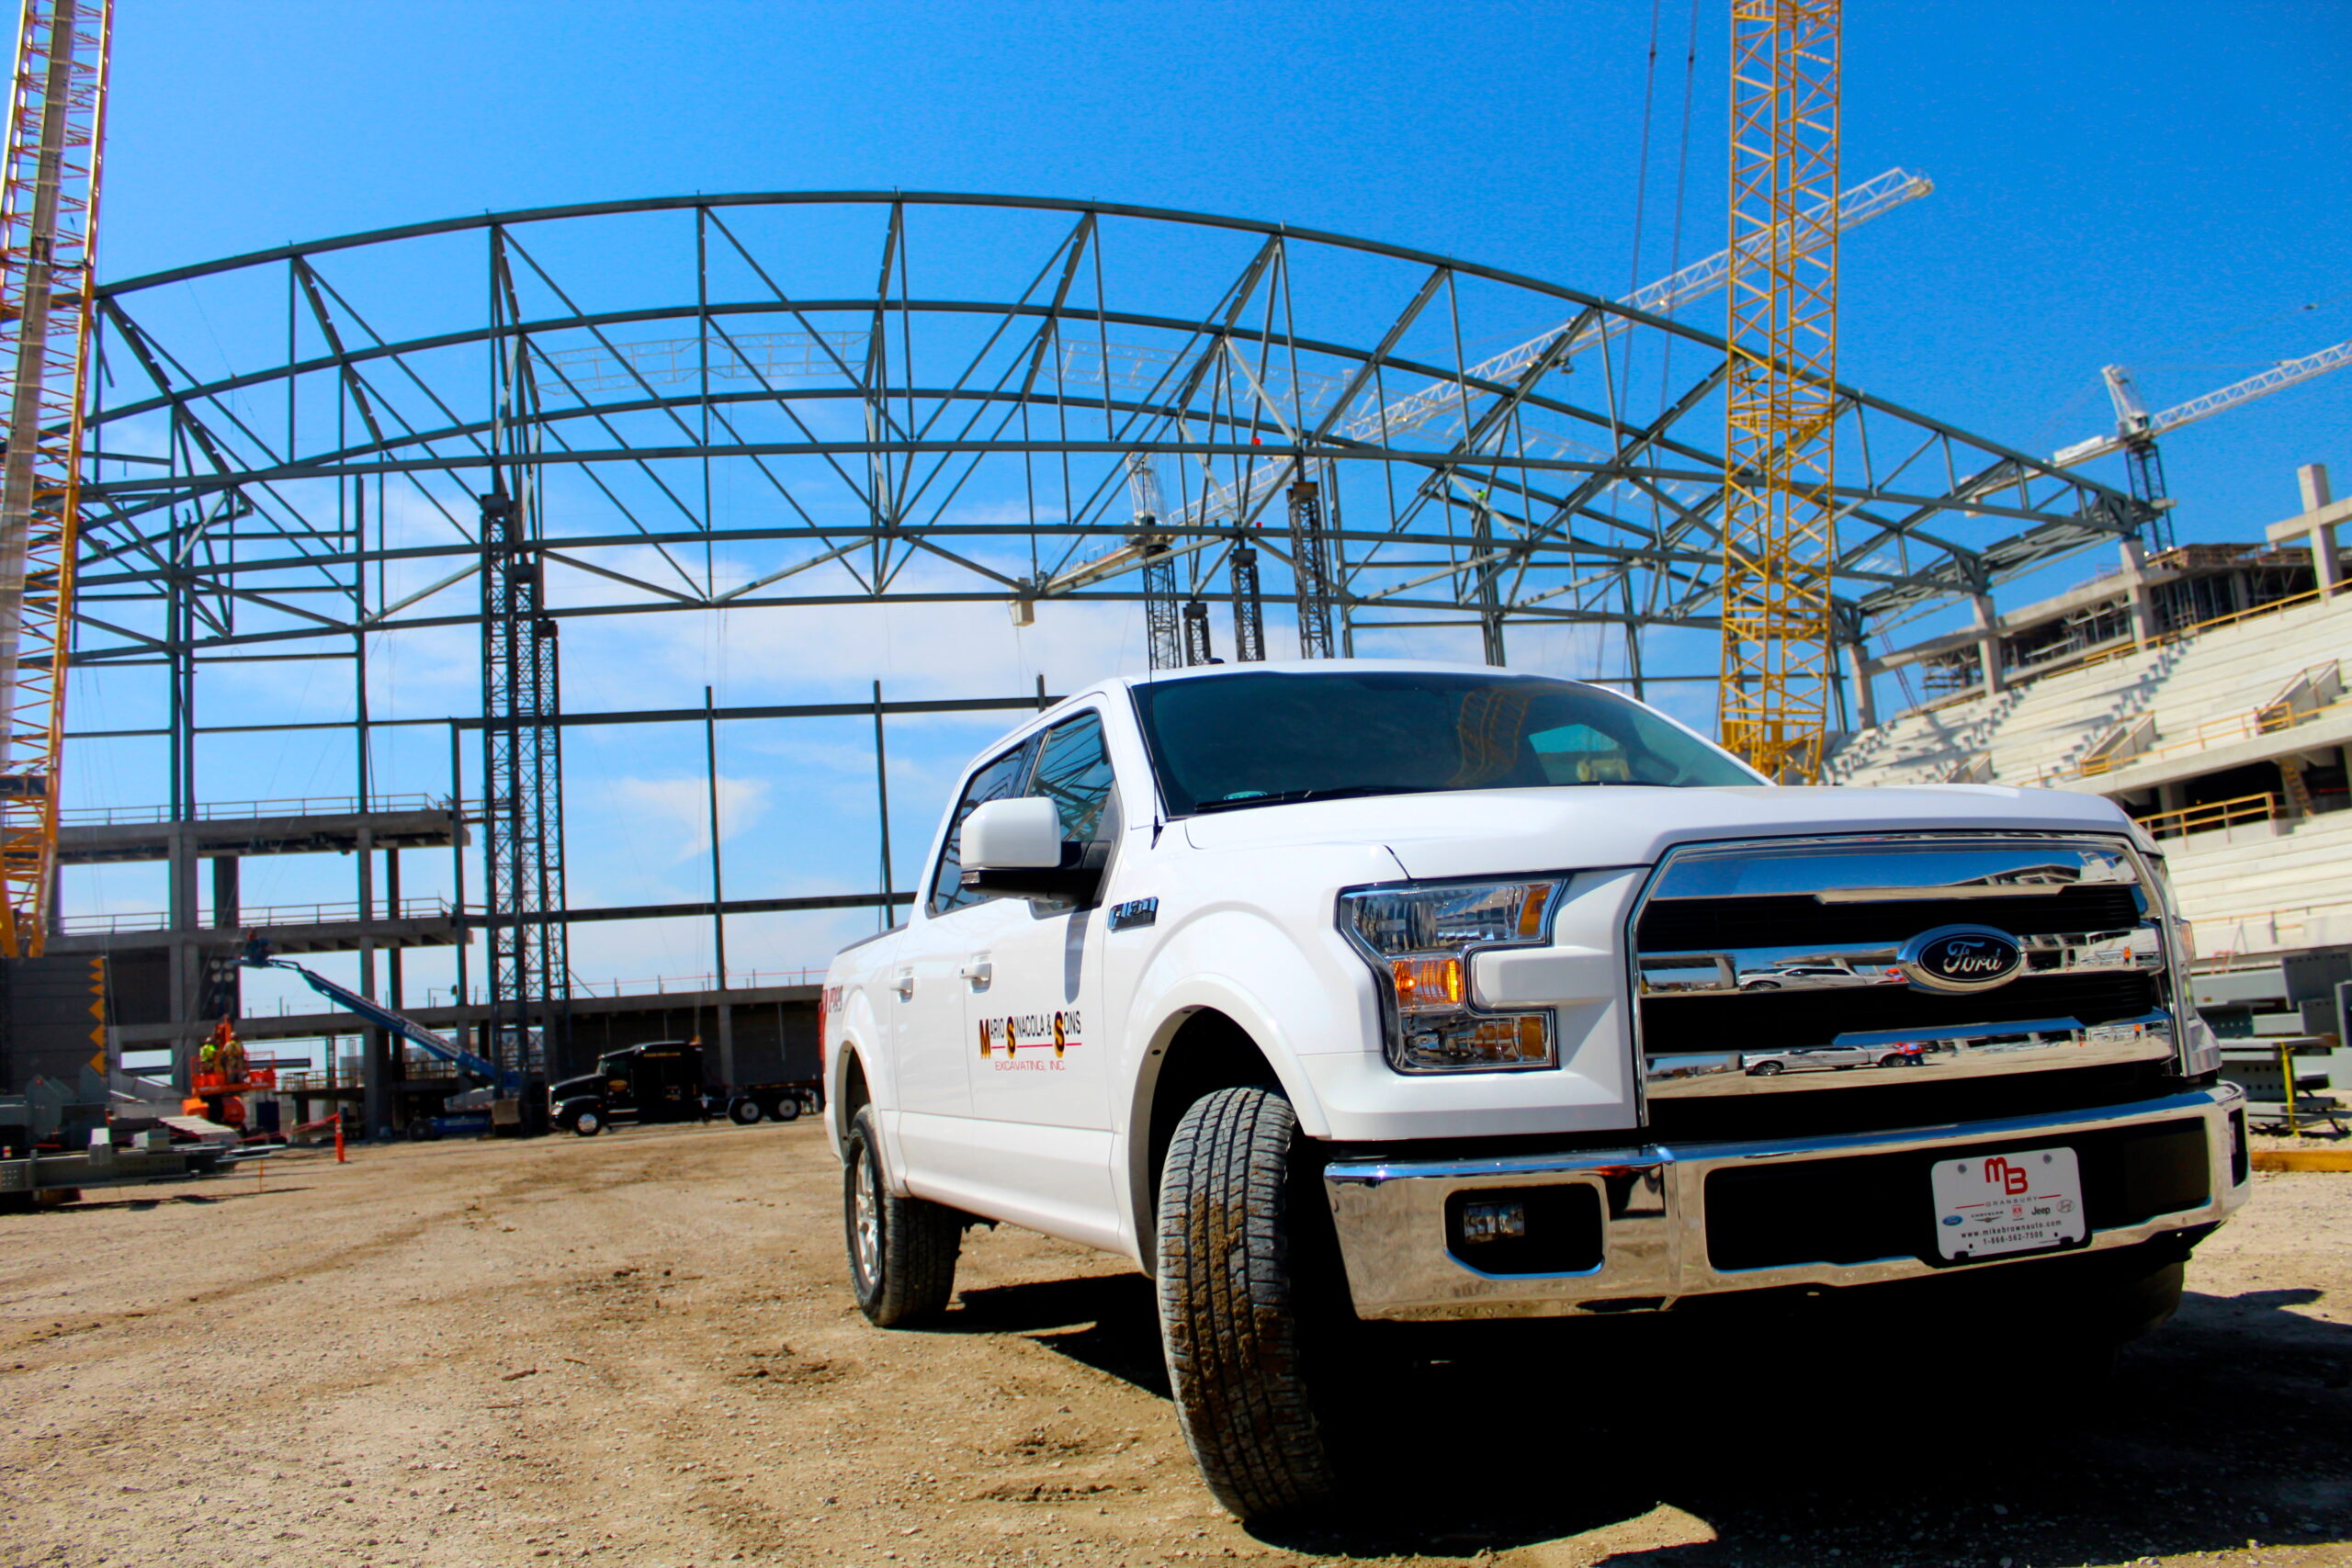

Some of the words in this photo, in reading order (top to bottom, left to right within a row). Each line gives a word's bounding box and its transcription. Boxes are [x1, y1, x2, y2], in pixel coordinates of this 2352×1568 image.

[1943, 941, 2002, 974] Ford
[979, 1019, 1005, 1059] MARIO
[1006, 1016, 1046, 1059] SINACOLA
[1046, 1013, 1053, 1037] &
[1054, 1010, 1081, 1058] SONS
[995, 1060, 1046, 1072] EXCAVATING,
[1985, 1197, 2039, 1207] GRANBURY
[2031, 1205, 2052, 1216] Jeep
[1962, 1220, 2062, 1238] www.mikebrownauto.com
